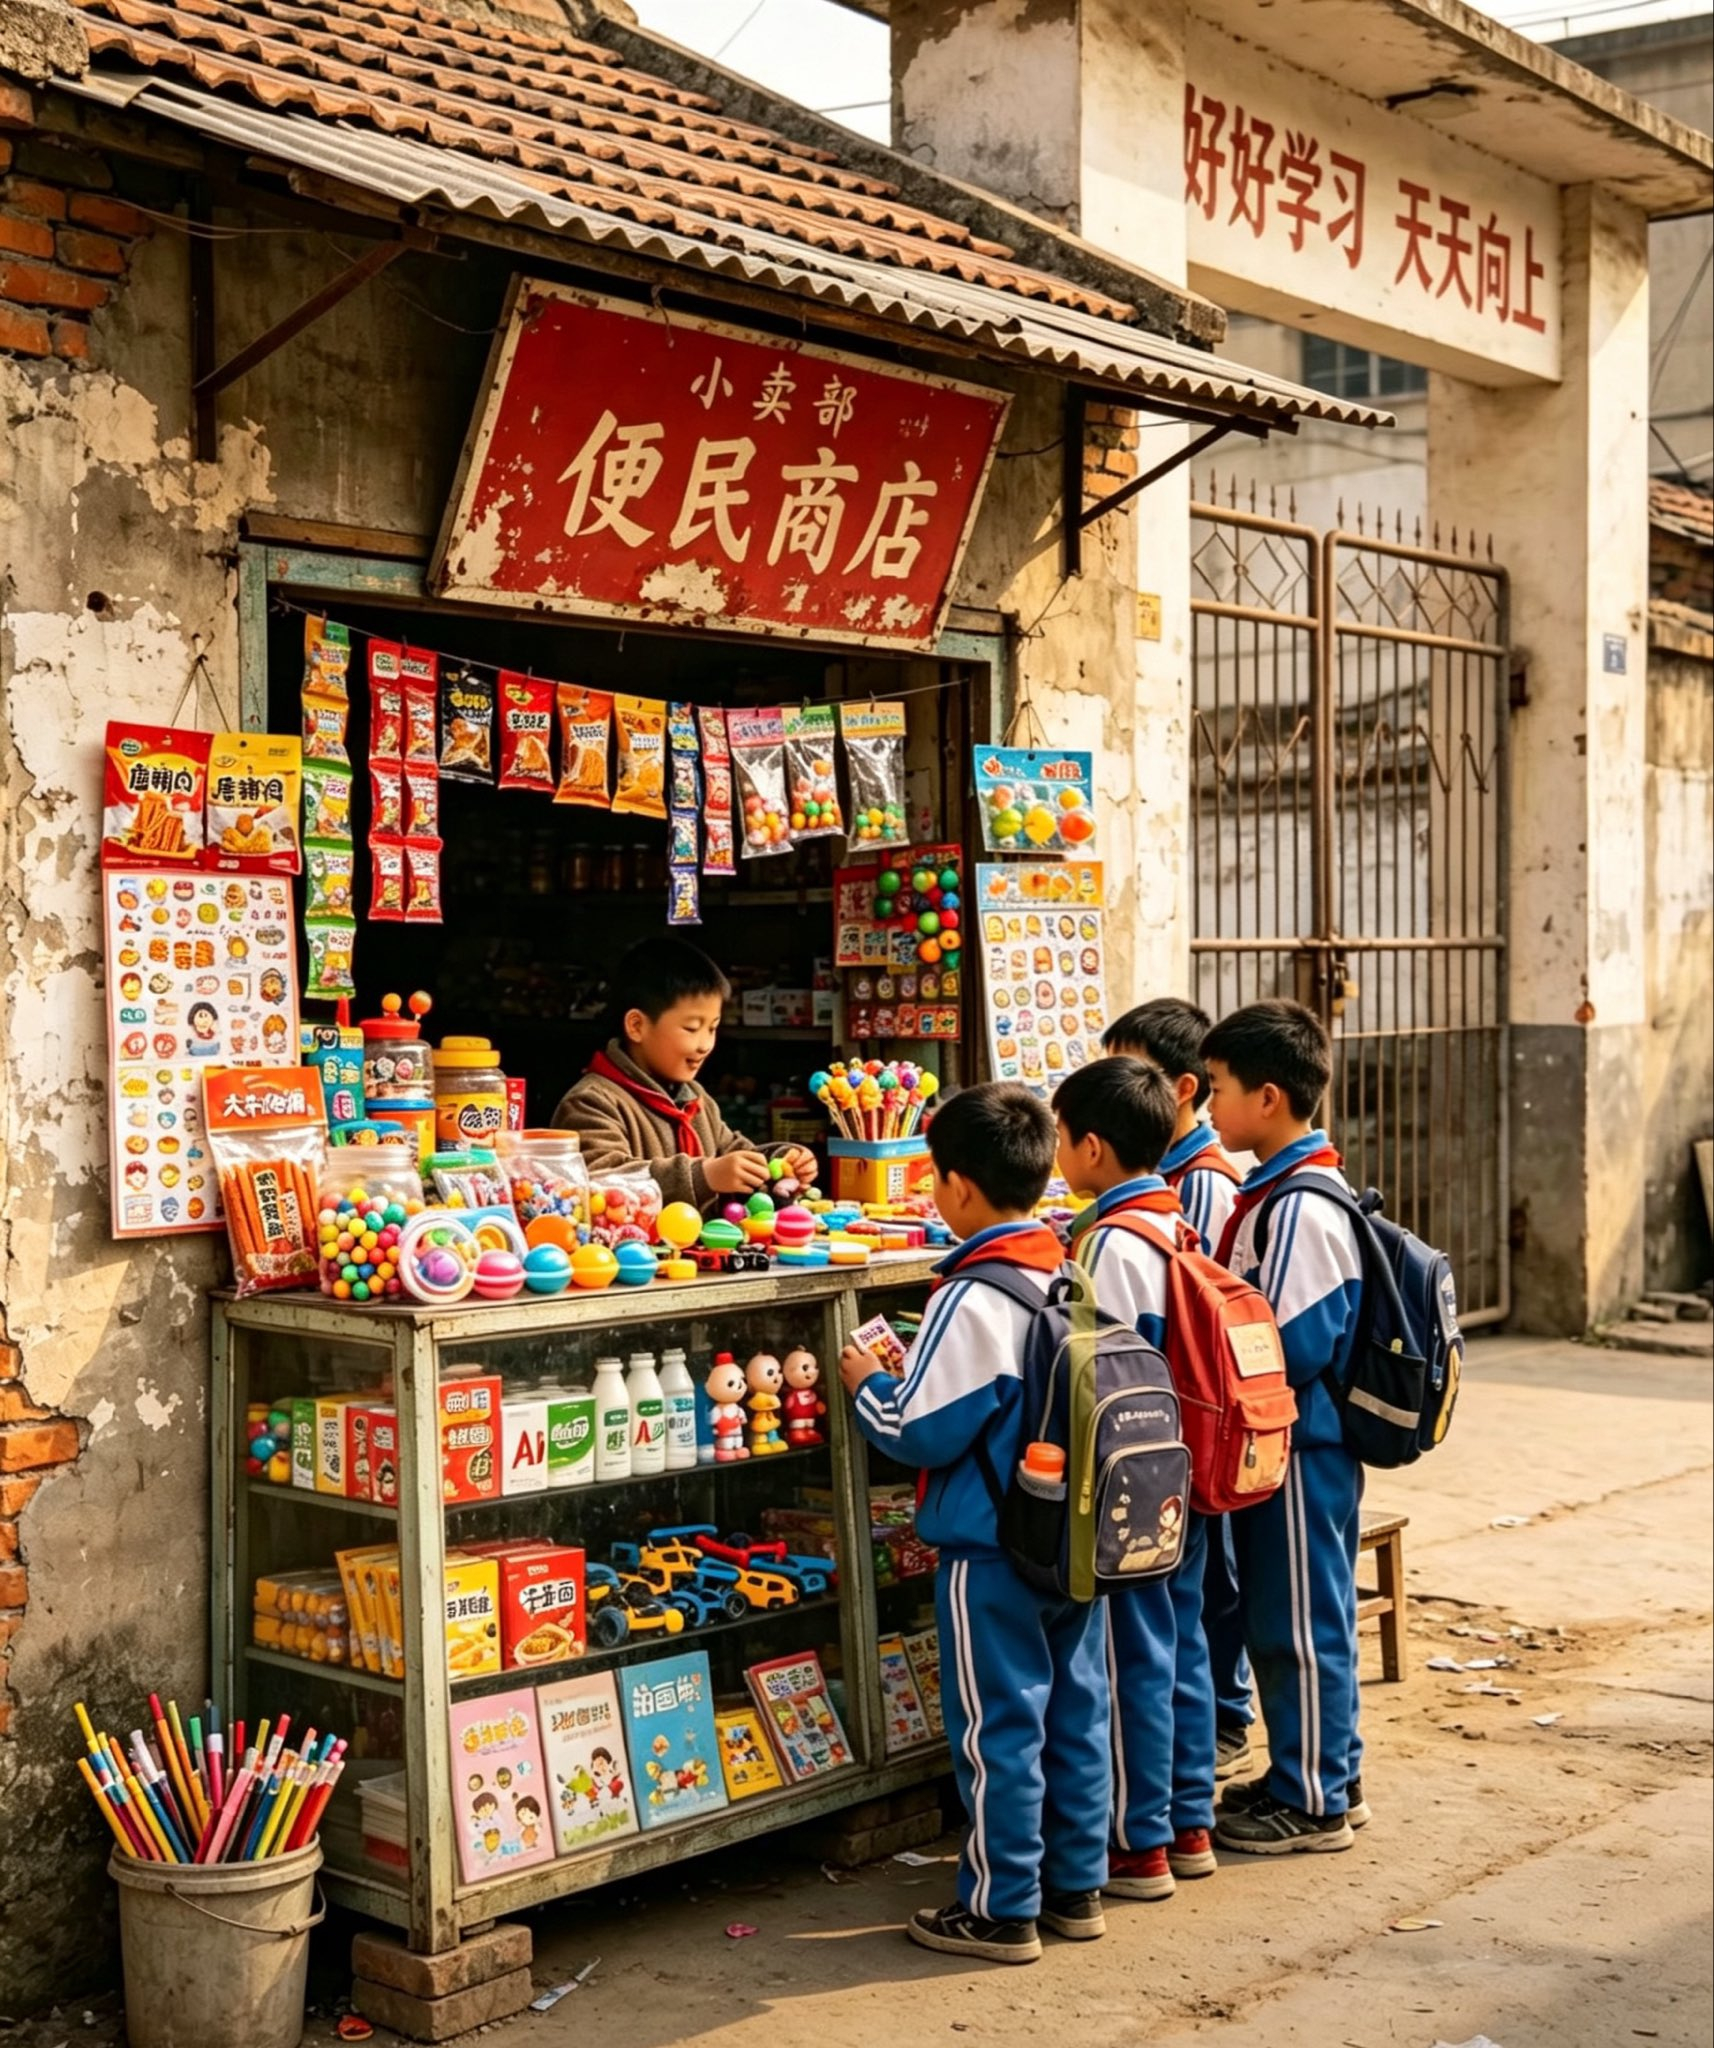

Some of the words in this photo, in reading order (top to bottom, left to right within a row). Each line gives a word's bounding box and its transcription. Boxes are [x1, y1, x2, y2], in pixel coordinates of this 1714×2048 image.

[1184, 82, 1366, 270] 好好学习
[1394, 178, 1547, 335] 天天向上
[690, 356, 858, 439] 小卖部
[557, 409, 938, 580] 便民商店
